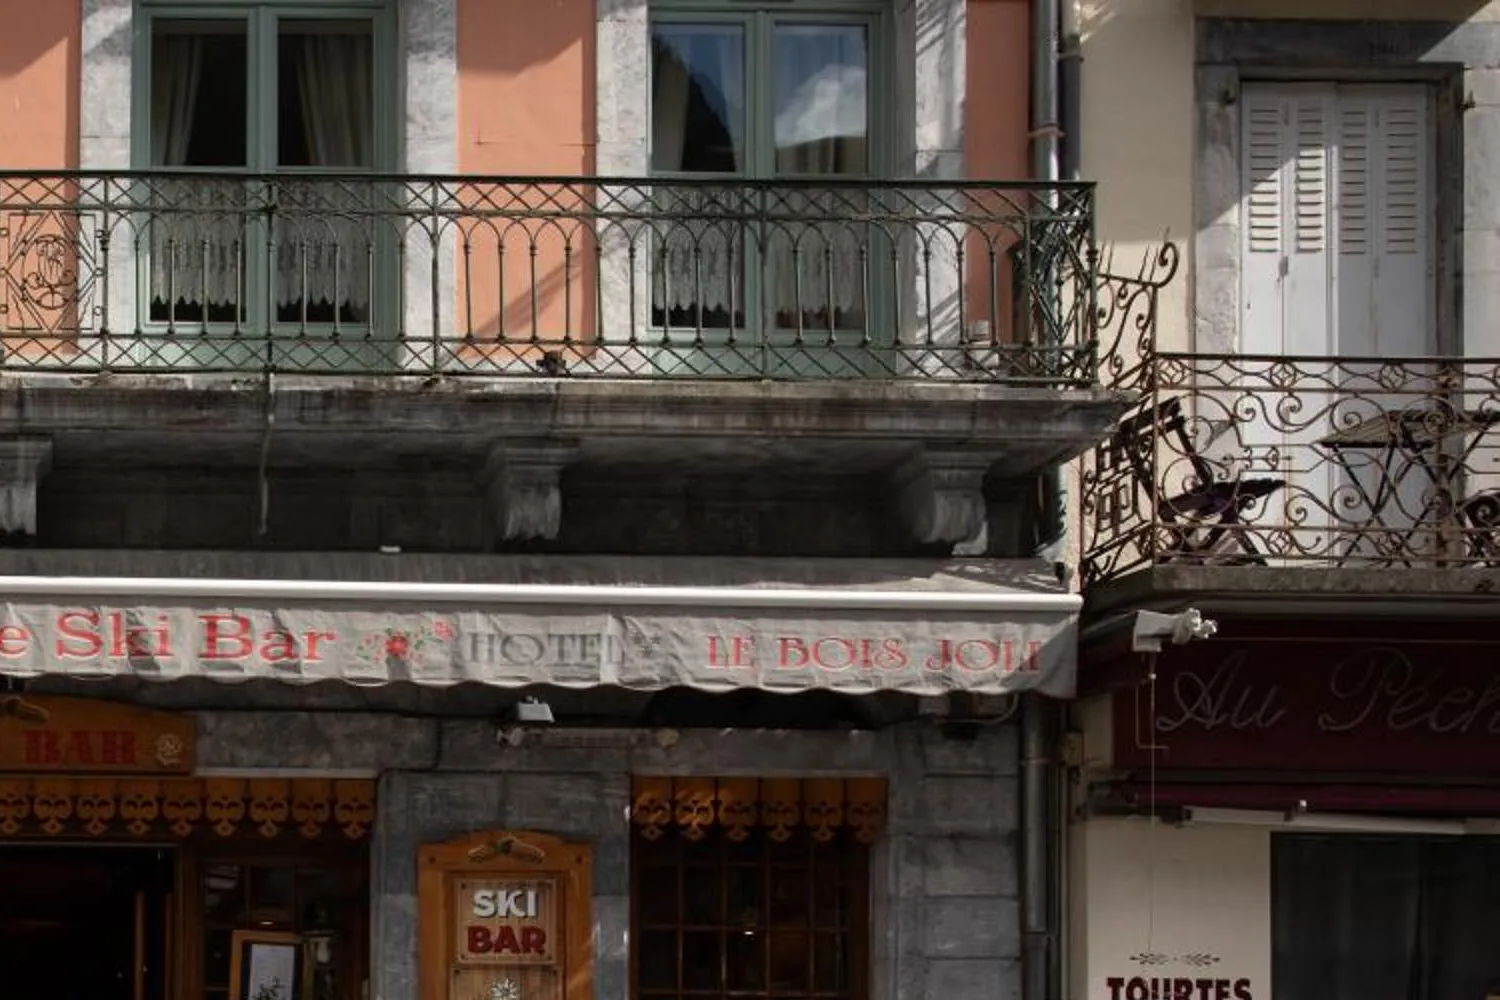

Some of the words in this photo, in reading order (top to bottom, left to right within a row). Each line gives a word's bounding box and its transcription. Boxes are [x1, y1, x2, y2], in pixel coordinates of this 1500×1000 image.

[54, 611, 174, 660] Ski
[197, 613, 337, 664] Bar
[467, 631, 627, 666] HOTEL
[705, 632, 756, 670] LE
[777, 635, 909, 672] BOIS
[924, 638, 1043, 673] JOLI
[1155, 648, 1288, 733] Au
[22, 728, 137, 766] BAR
[472, 888, 537, 918] SKI
[466, 925, 547, 955] BAR
